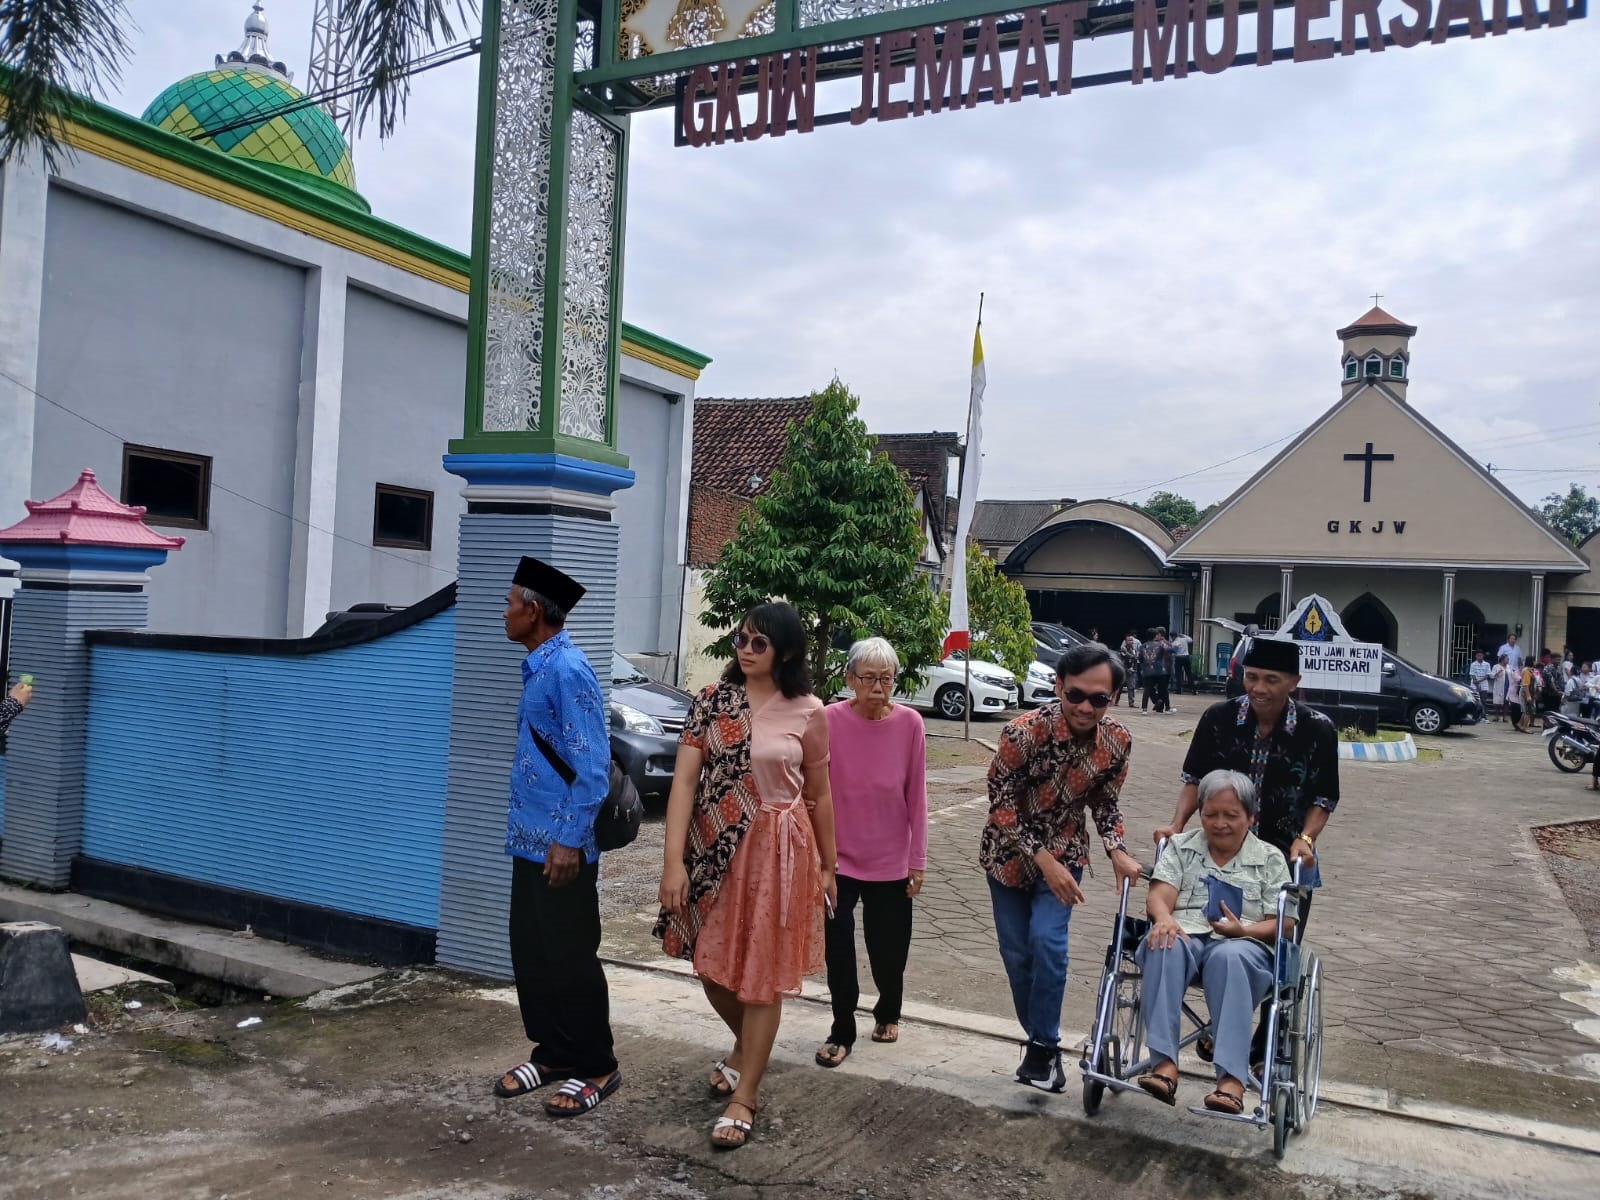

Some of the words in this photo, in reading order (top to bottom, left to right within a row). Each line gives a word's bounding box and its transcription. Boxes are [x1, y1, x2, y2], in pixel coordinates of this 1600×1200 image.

[682, 46, 816, 148] GKJW
[850, 1, 1088, 126] JEMAAT
[1131, 0, 1569, 85] MUTER
[1327, 520, 1407, 535] GKJW
[1324, 646, 1345, 658] JAWI
[1349, 647, 1379, 660] WETAN
[1304, 658, 1370, 674] MUTERSARI
